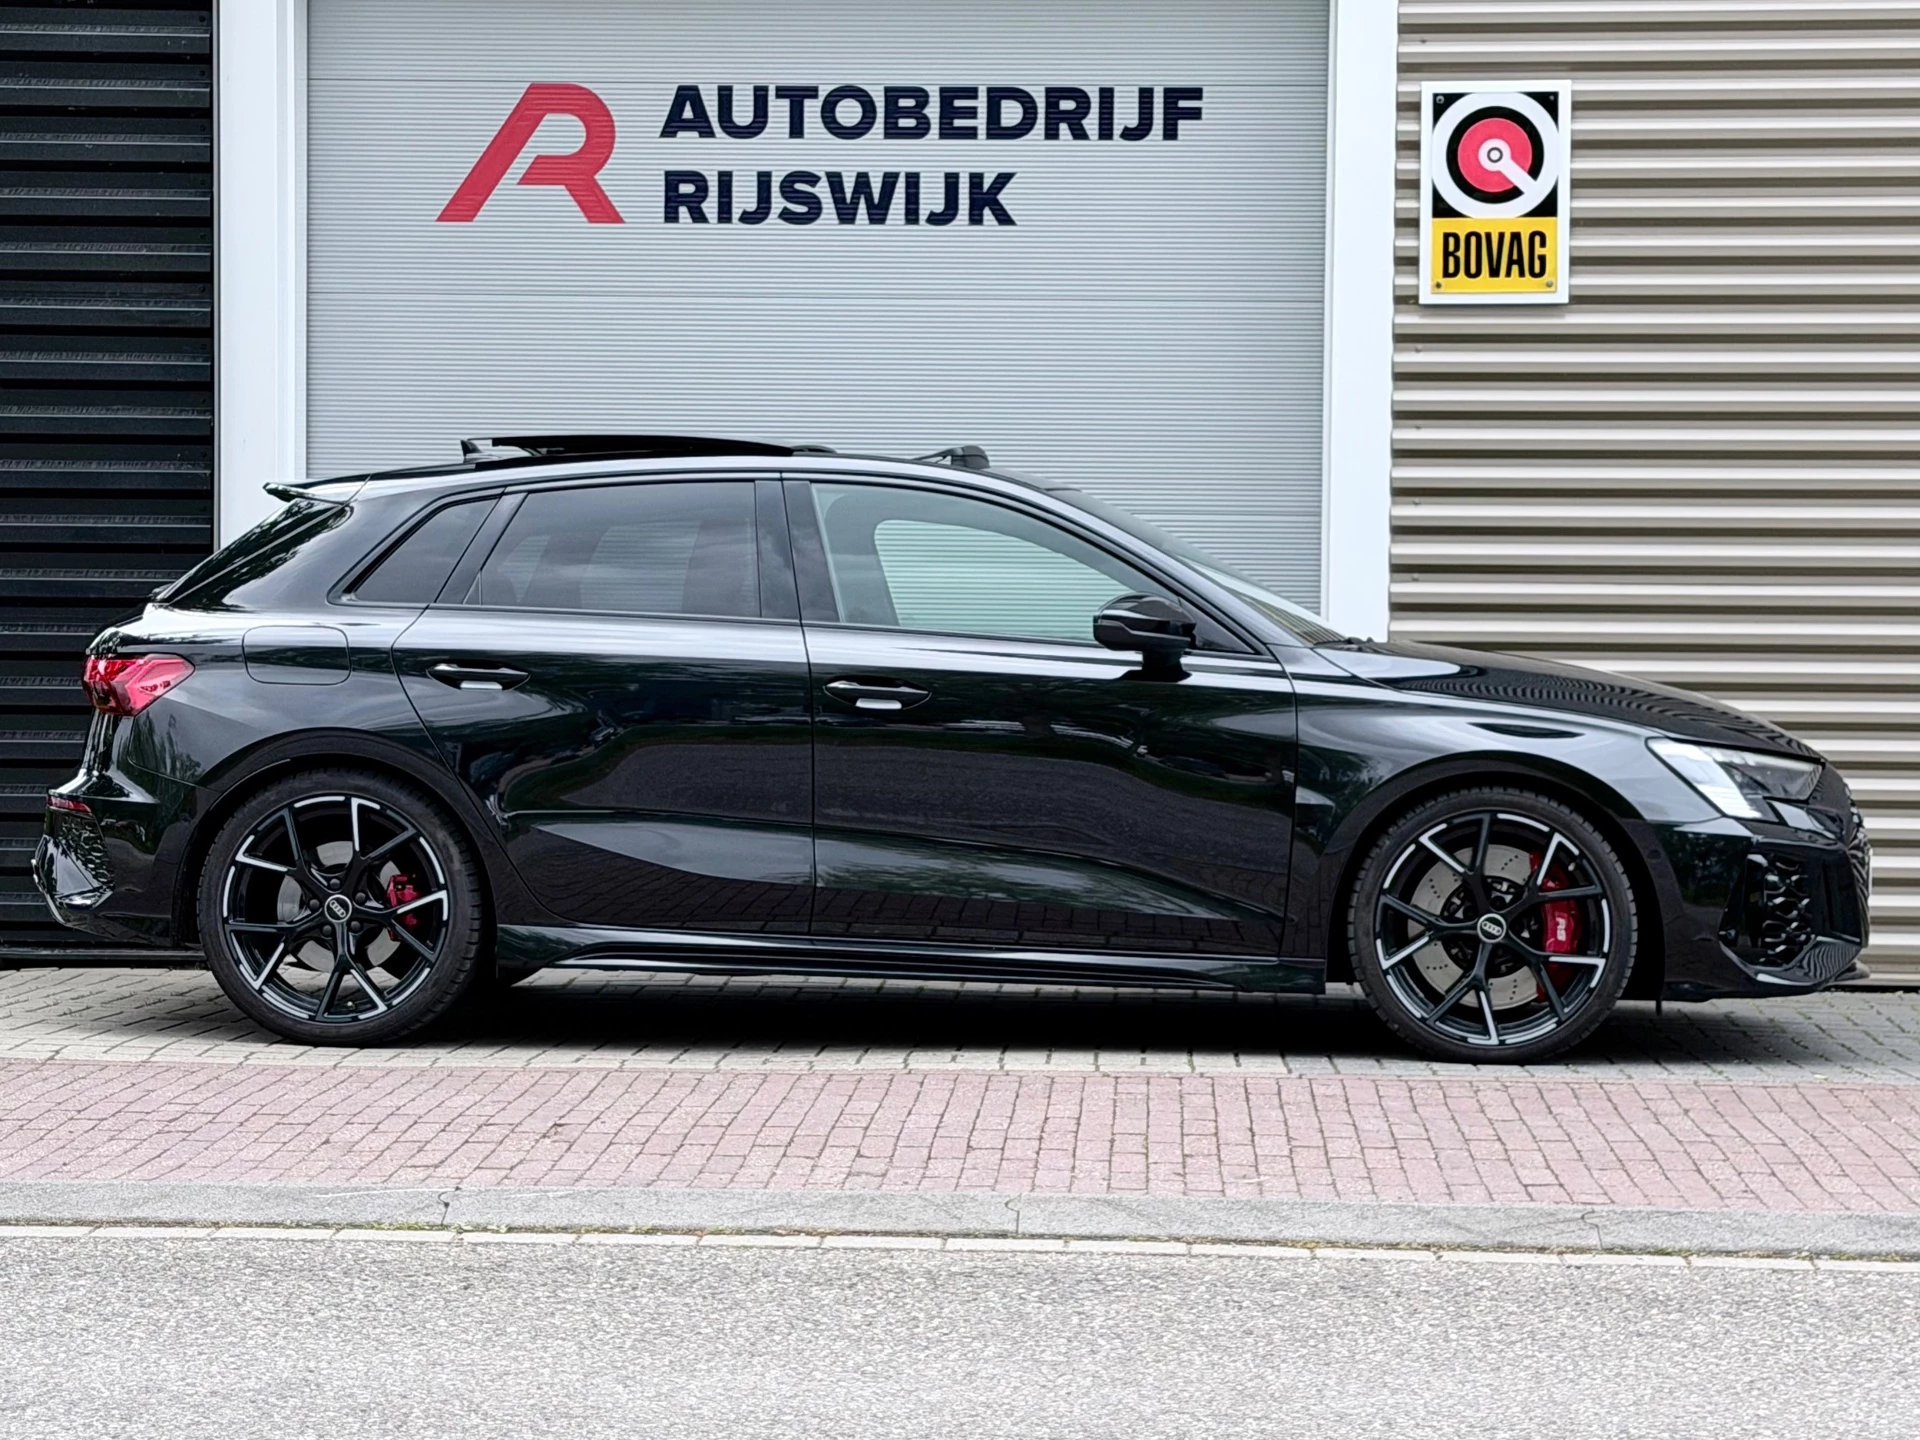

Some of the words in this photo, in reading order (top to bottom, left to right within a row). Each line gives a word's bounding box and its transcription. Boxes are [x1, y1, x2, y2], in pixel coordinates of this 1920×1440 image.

[659, 85, 1204, 142] AUTOBEDRIJF
[662, 170, 1018, 227] RIJSWIJK
[1442, 230, 1547, 279] BOVAG
